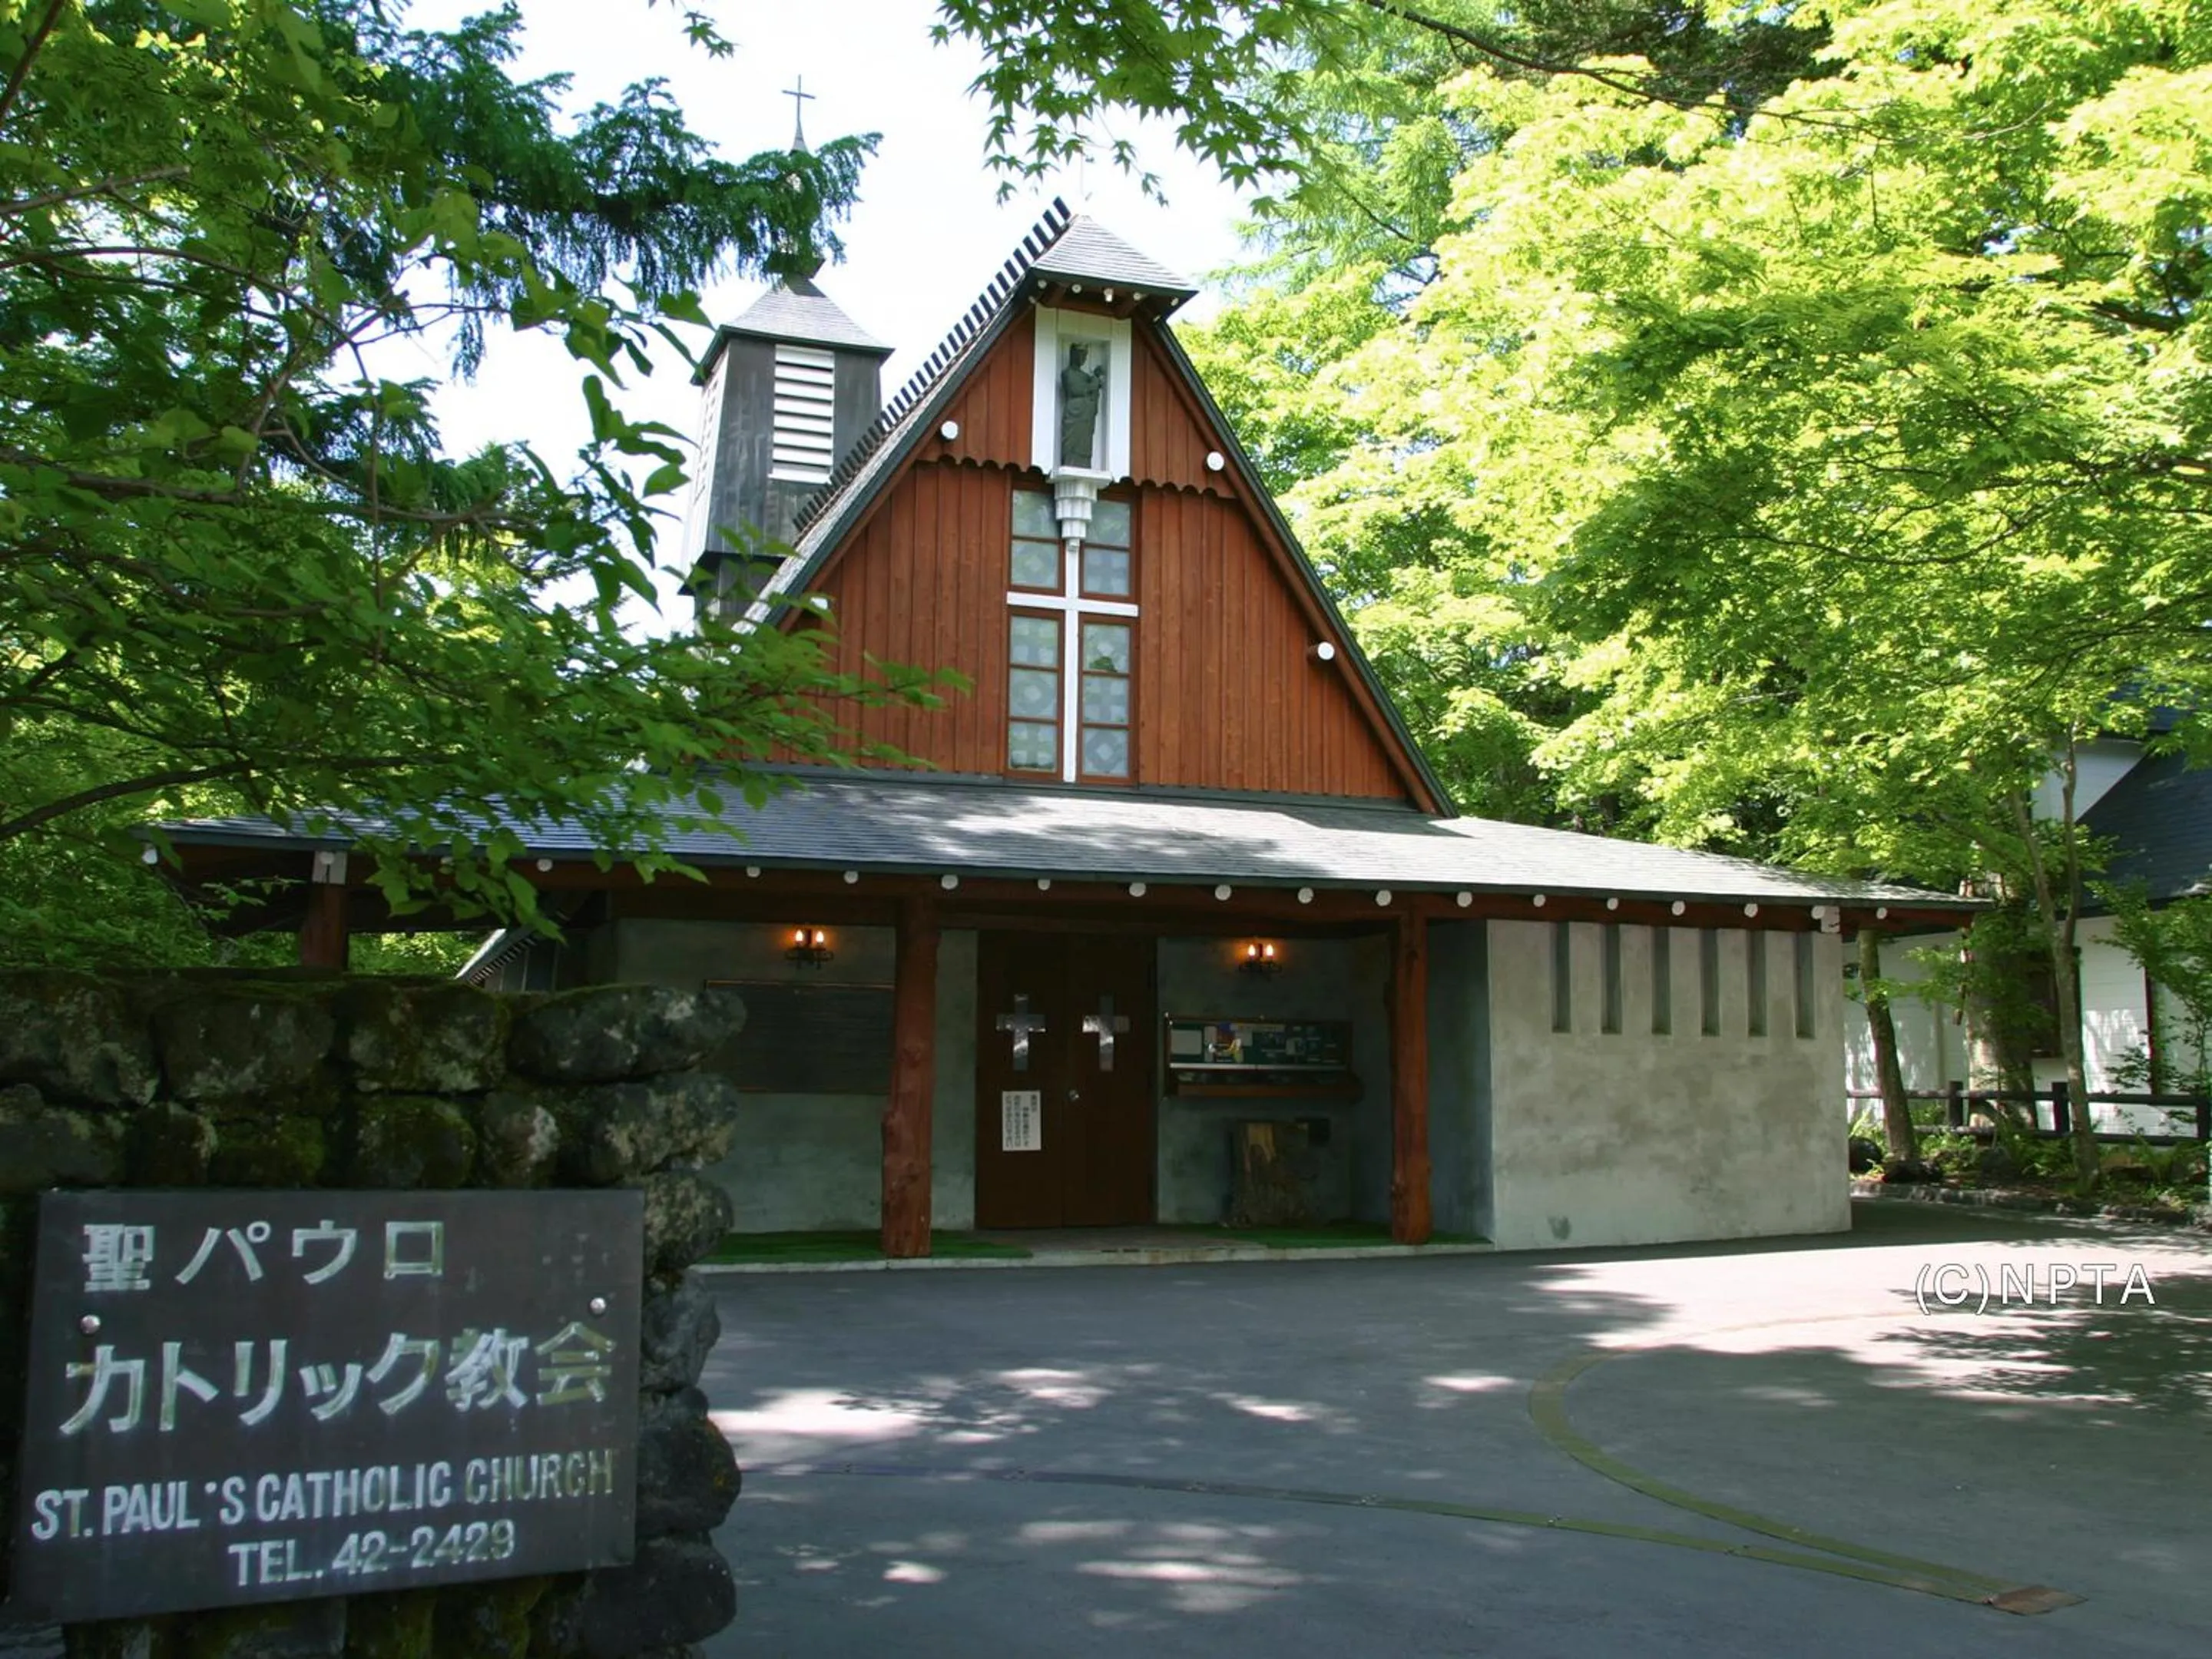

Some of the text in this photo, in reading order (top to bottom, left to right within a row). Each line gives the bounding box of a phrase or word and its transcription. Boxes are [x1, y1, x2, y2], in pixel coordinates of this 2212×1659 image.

[82, 1219, 445, 1293] 聖パウロ
[58, 1321, 616, 1435] カトリック教会
[31, 1487, 94, 1540] ST.
[256, 1459, 452, 1521] CATHOLIC
[464, 1449, 614, 1504] CHURCH
[228, 1518, 516, 1586] TEL. 42-2429
